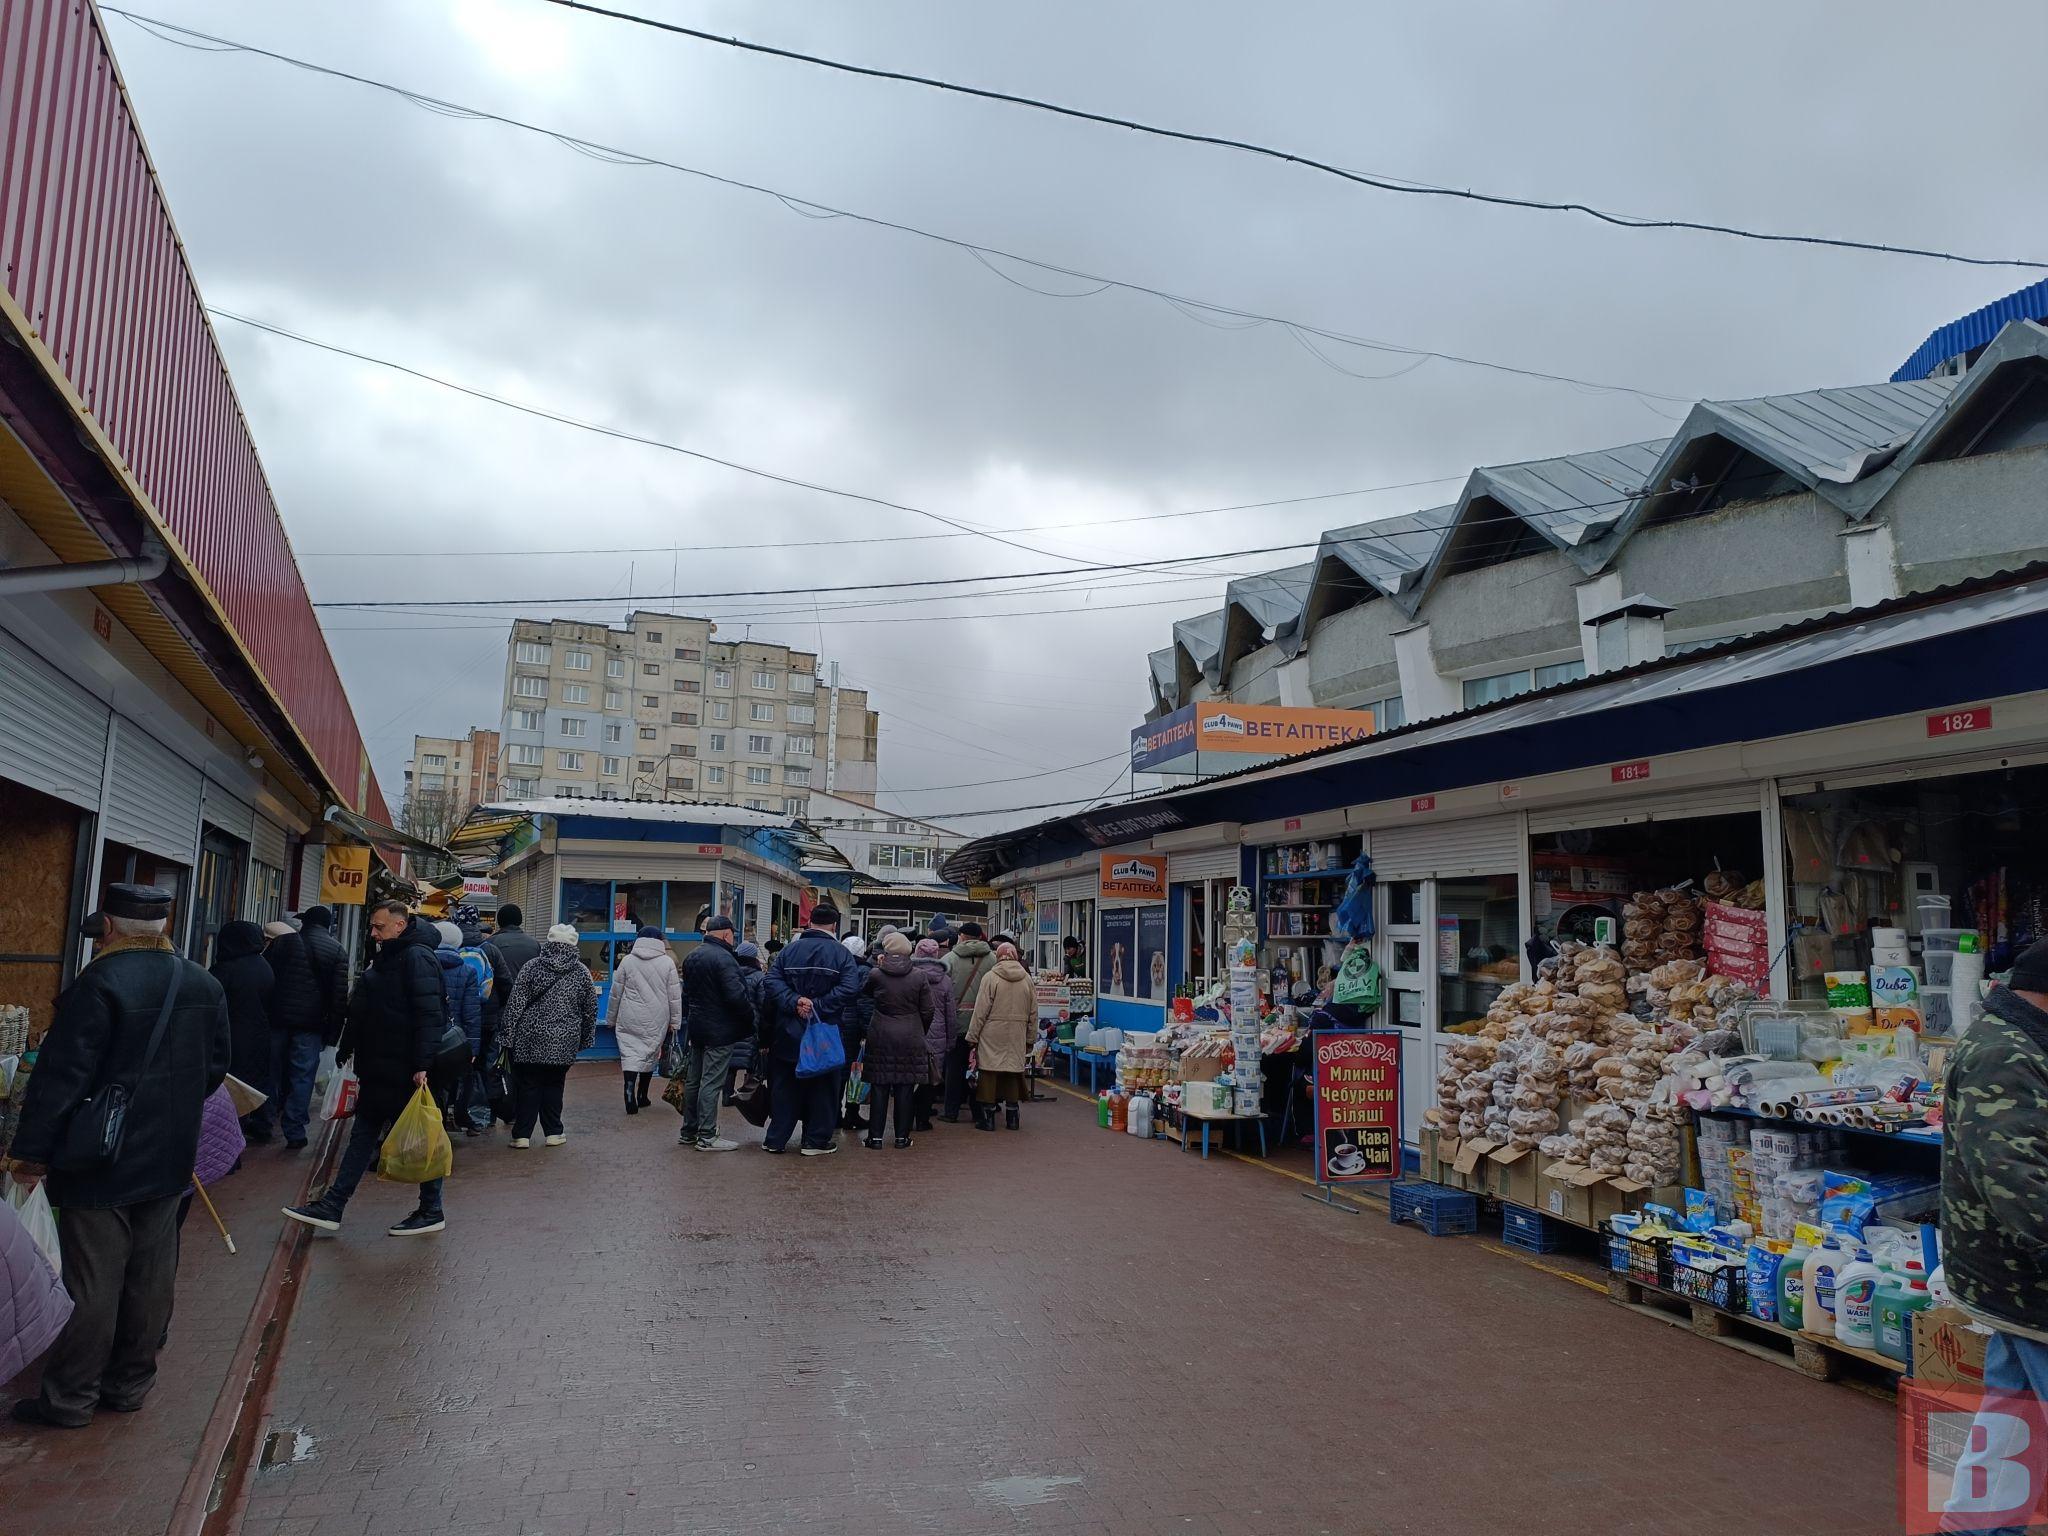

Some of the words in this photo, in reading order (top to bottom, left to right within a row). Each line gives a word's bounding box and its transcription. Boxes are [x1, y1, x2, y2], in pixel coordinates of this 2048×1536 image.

[1219, 715, 1226, 727] 4
[1227, 721, 1242, 730] PAWS
[1247, 721, 1367, 740] ВЕТАПТЕКА
[1943, 713, 1973, 732] 182
[1147, 720, 1194, 751] ВЕТАПТЕКА
[1620, 766, 1639, 779] 181
[1114, 867, 1128, 875] CLUB
[1129, 861, 1138, 875] 4
[1139, 868, 1155, 878] PAWS
[1102, 881, 1163, 893] ВЕТАПТЕКА
[1876, 977, 1909, 991] Диво
[1318, 1039, 1396, 1065] ОБЖОРА
[1330, 1066, 1385, 1083] Млинці
[1320, 1087, 1394, 1105] Чебуреки
[1332, 1106, 1384, 1123] Біляші
[1357, 1130, 1389, 1145] Кава
[1366, 1147, 1390, 1163] Чай
[1846, 1309, 1870, 1317] WASH
